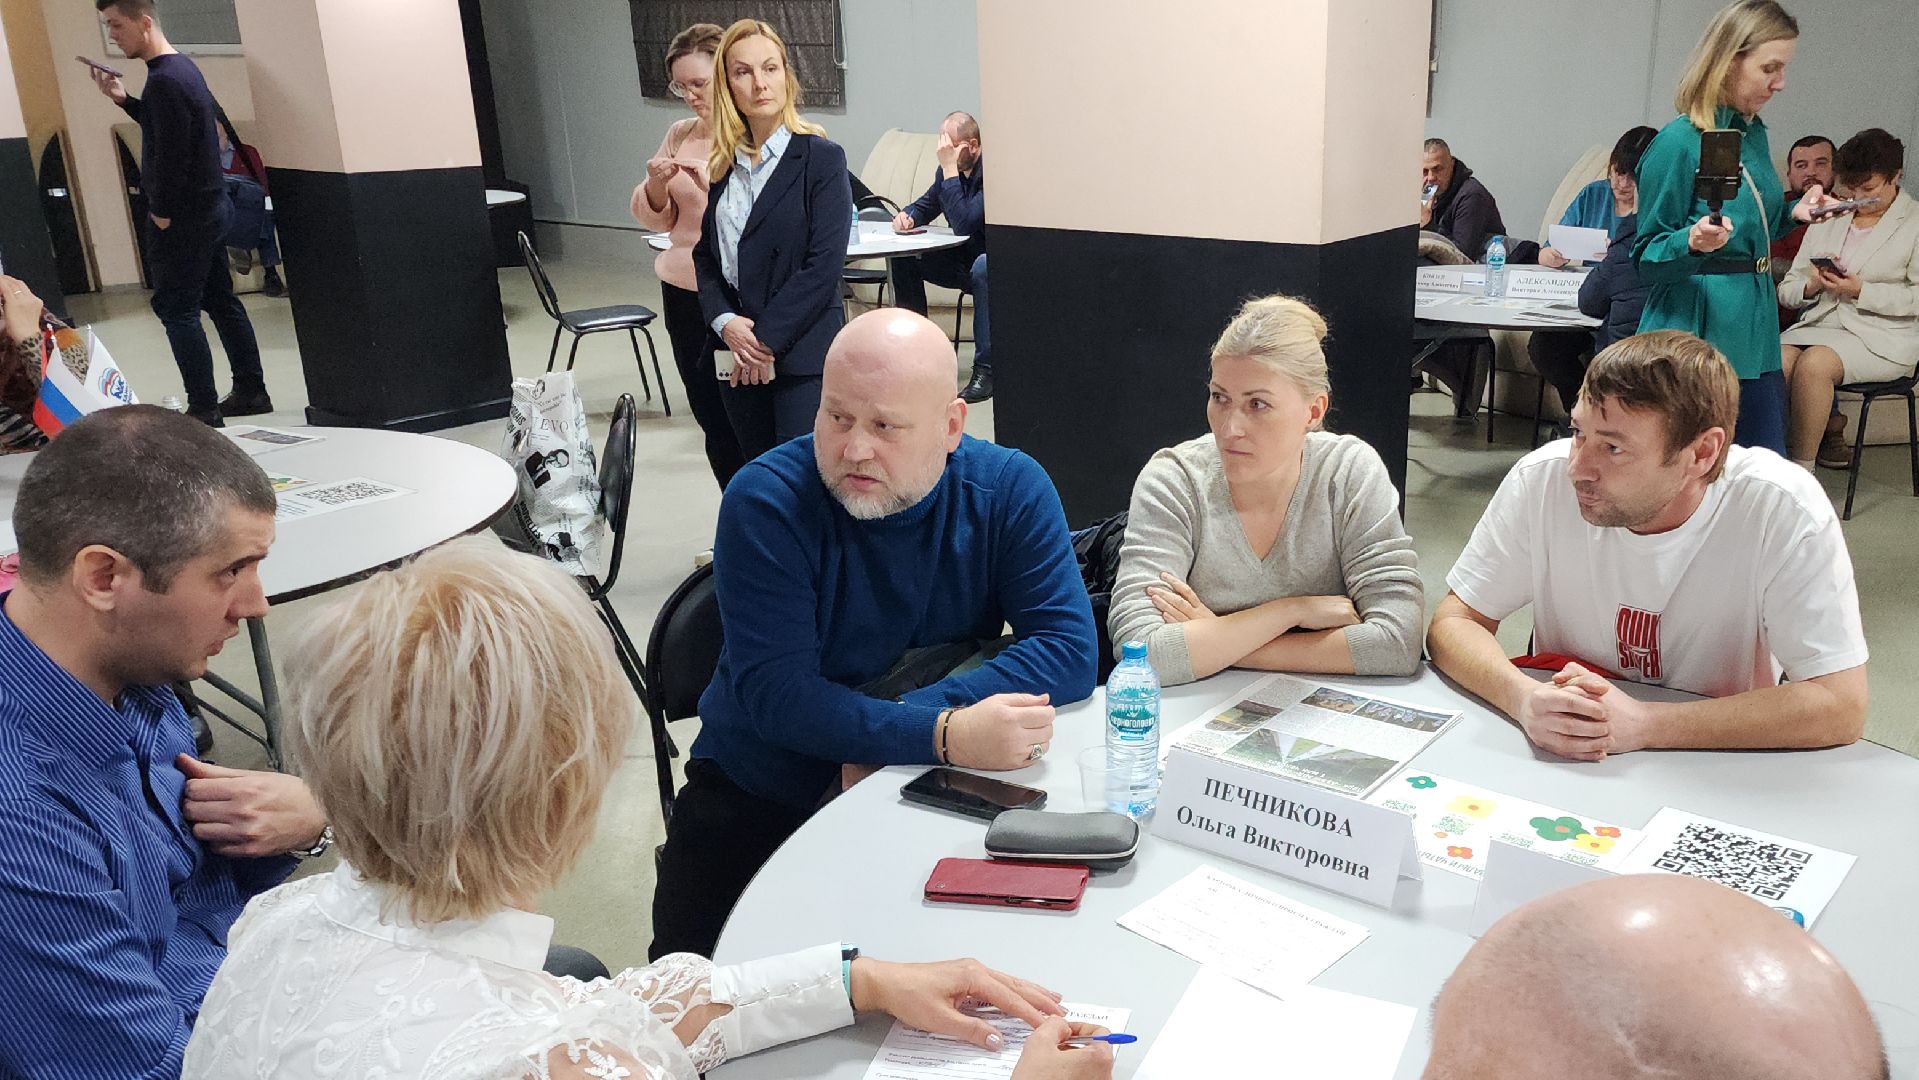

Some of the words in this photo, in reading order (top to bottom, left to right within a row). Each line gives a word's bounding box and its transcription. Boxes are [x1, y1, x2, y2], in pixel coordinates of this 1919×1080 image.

[1202, 776, 1353, 838] ПЕЧНИКОВА
[1176, 805, 1236, 840] Ольга
[1242, 823, 1371, 880] Викторовна
